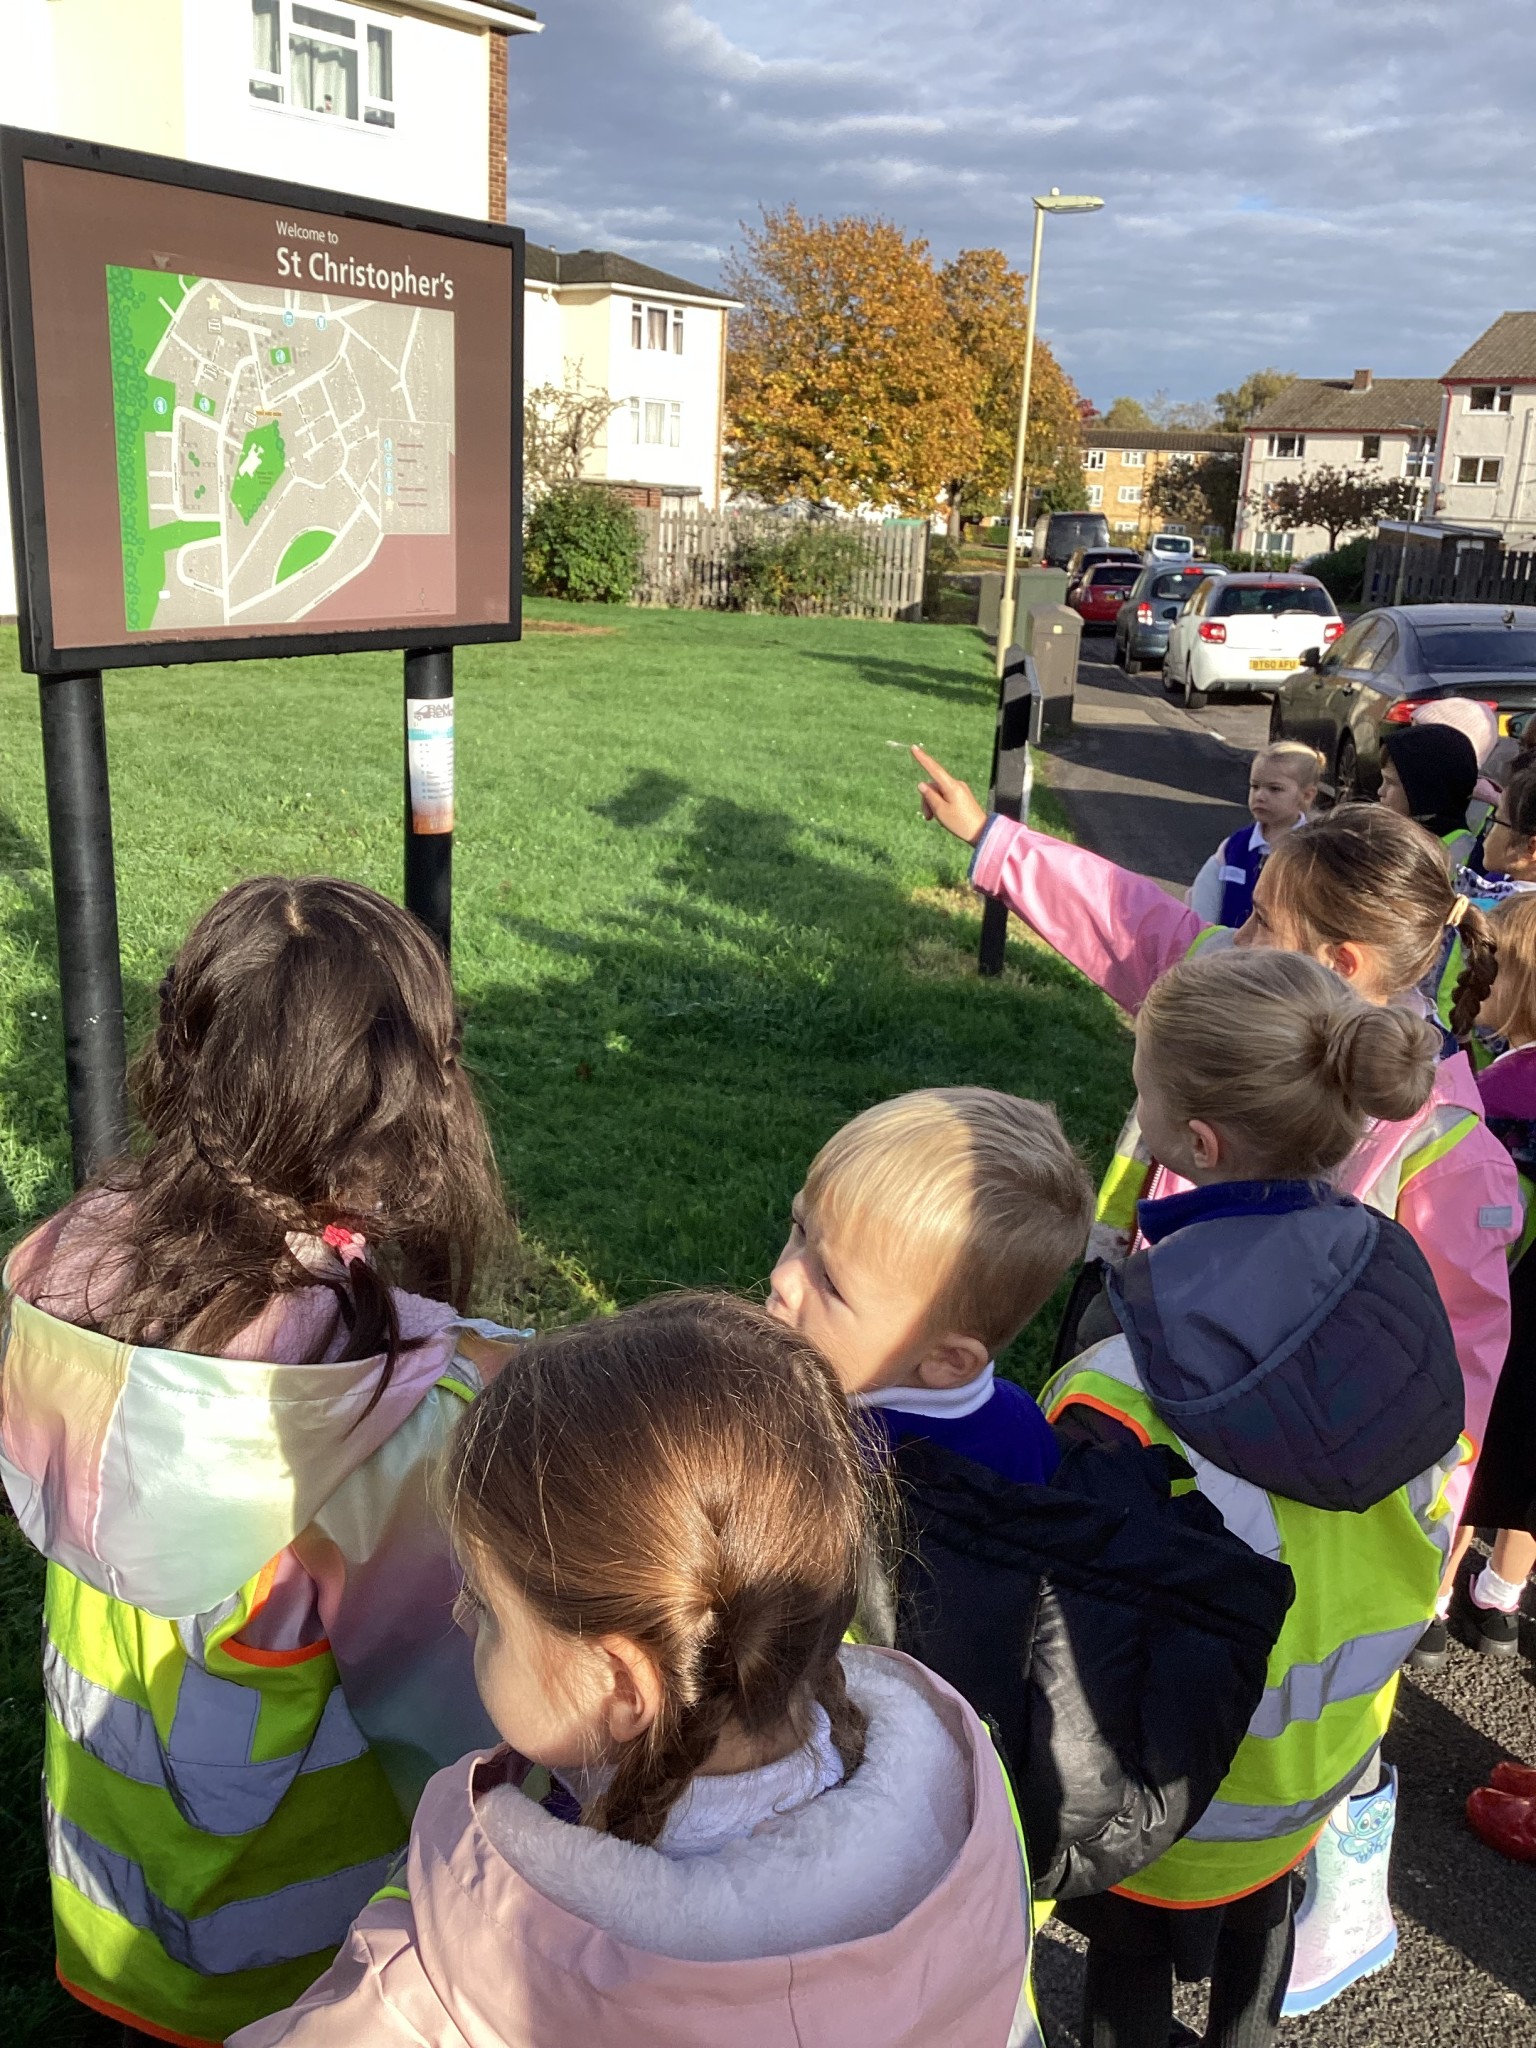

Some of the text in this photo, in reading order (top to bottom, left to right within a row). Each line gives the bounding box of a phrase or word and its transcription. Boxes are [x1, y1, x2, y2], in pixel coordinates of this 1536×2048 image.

[276, 220, 339, 244] Welcome to
[276, 246, 454, 300] St Christopher's
